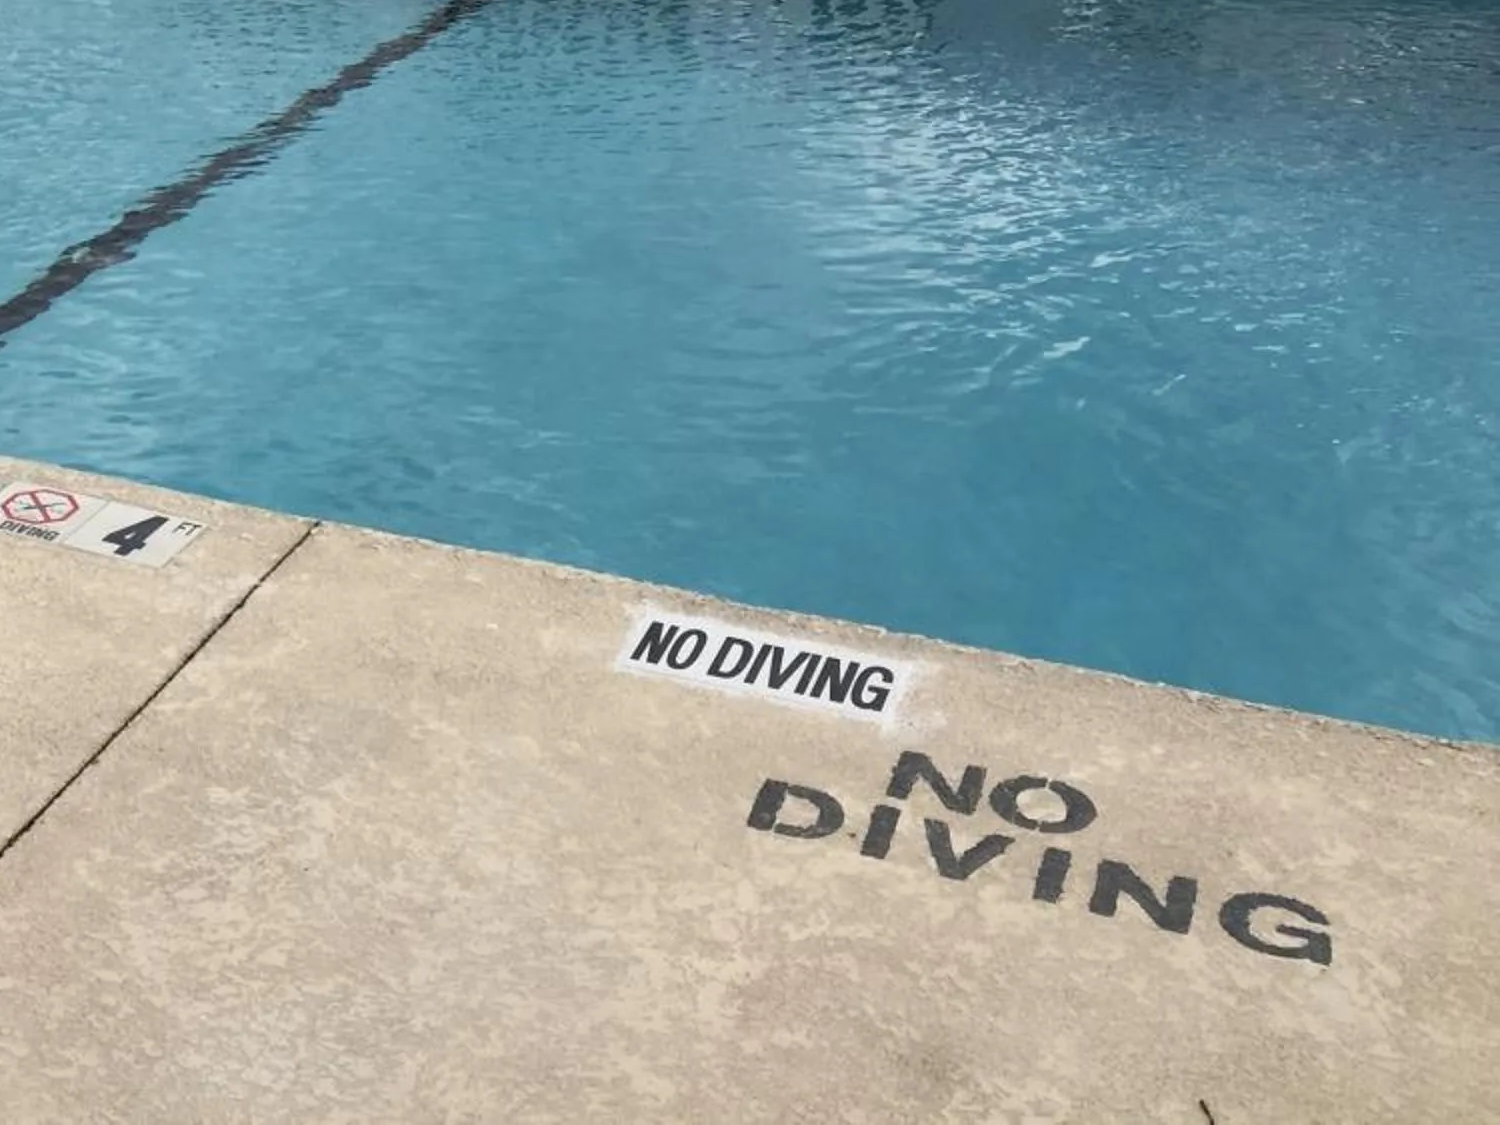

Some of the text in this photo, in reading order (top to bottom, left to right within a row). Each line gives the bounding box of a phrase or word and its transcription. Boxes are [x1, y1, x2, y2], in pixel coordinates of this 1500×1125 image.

[0, 520, 61, 542] DIVING
[101, 515, 169, 556] 4
[630, 619, 896, 713] NO DIVING
[886, 750, 1098, 835] NO
[746, 777, 1334, 967] DIVING
